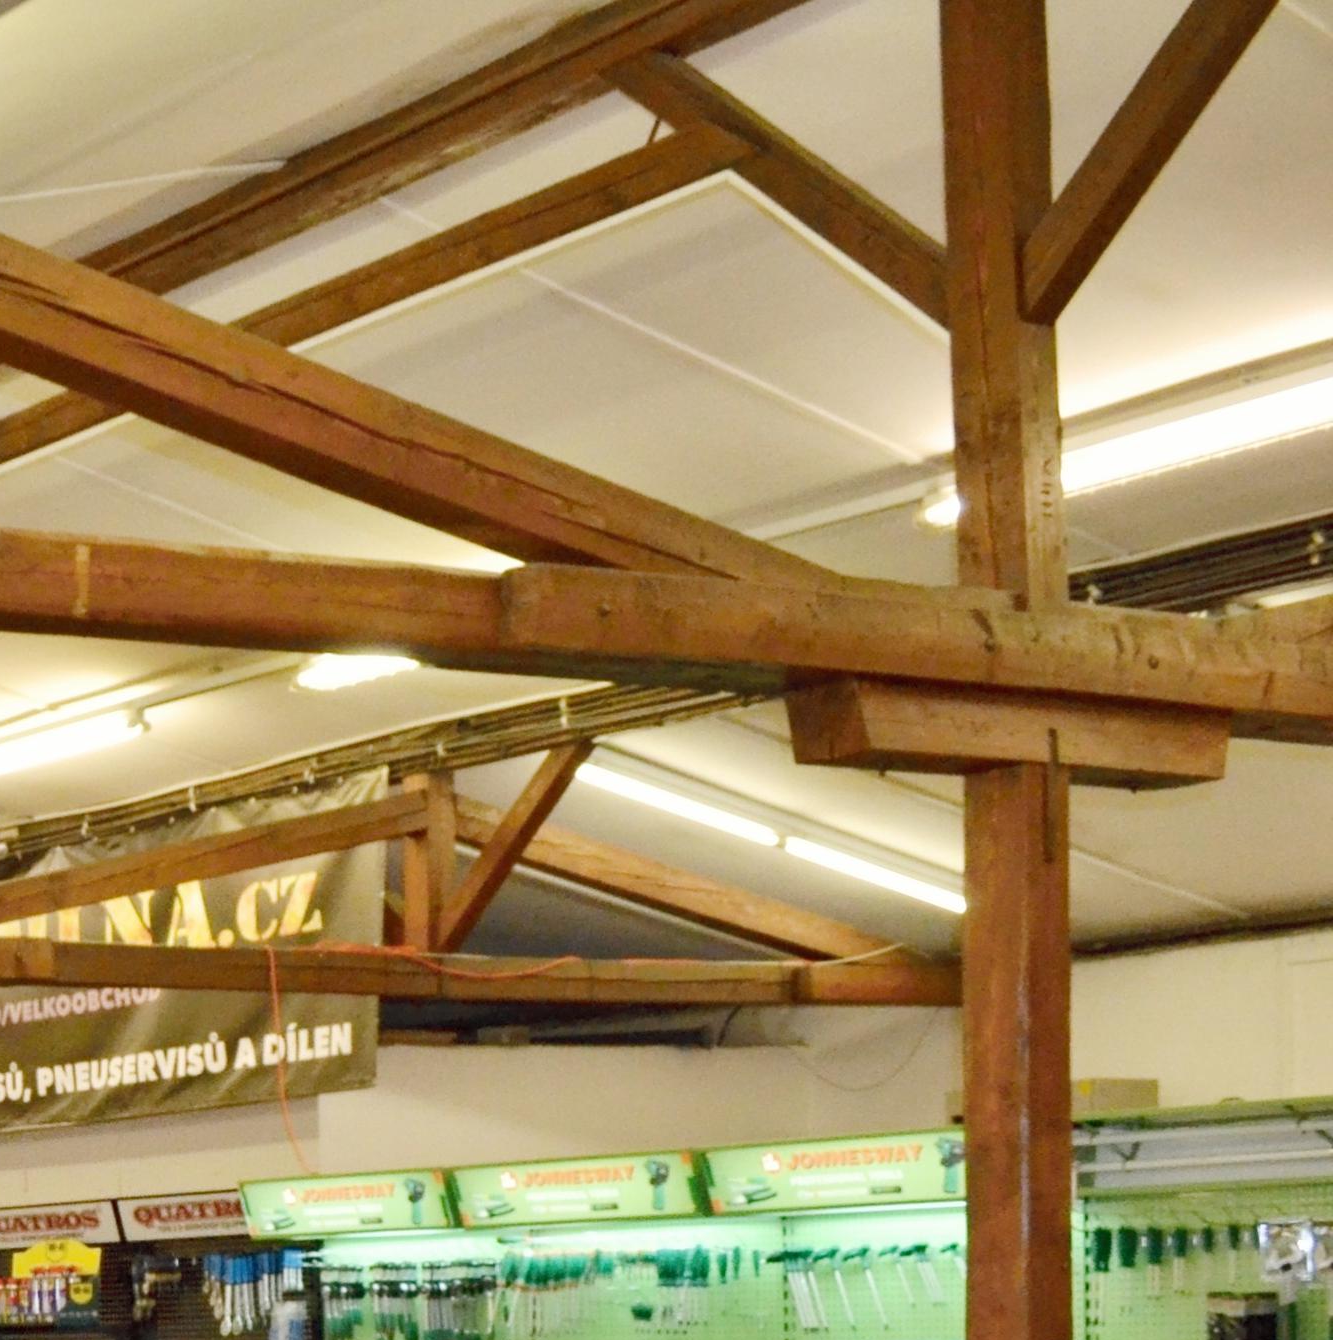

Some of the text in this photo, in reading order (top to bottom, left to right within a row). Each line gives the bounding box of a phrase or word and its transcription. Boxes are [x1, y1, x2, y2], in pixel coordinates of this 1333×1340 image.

[37, 1031, 227, 1096] PNEUSERVISŮ
[233, 1039, 257, 1071] A
[261, 1021, 352, 1067] DÍLEN
[787, 1144, 924, 1171] JONNESWAY
